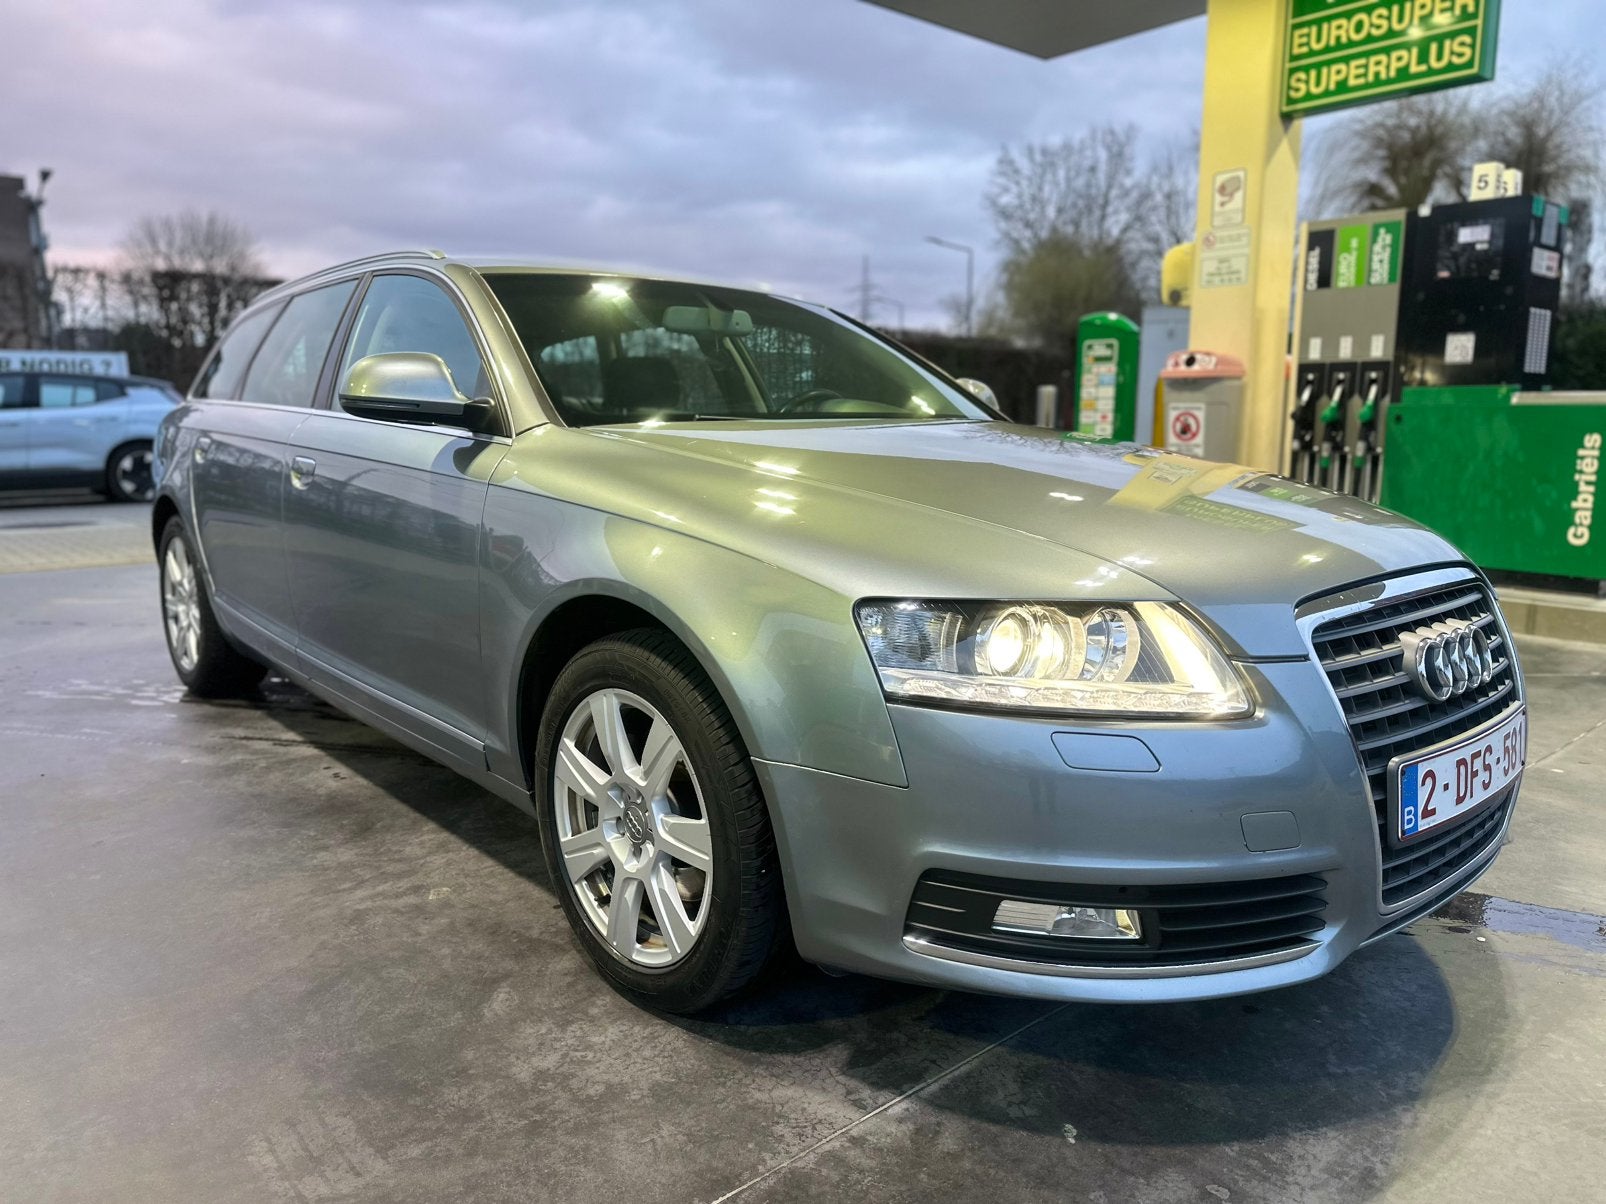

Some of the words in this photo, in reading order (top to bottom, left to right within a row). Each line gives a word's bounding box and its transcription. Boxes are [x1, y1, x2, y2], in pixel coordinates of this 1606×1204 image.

[1291, 0, 1476, 55] EUROSUPER
[1288, 34, 1473, 98] SUPERPLUS
[1476, 173, 1489, 191] 5
[1306, 246, 1320, 290] DIESEL
[20, 357, 94, 374] NODIG
[1566, 432, 1602, 546] Gabriëls
[1404, 806, 1415, 829] B
